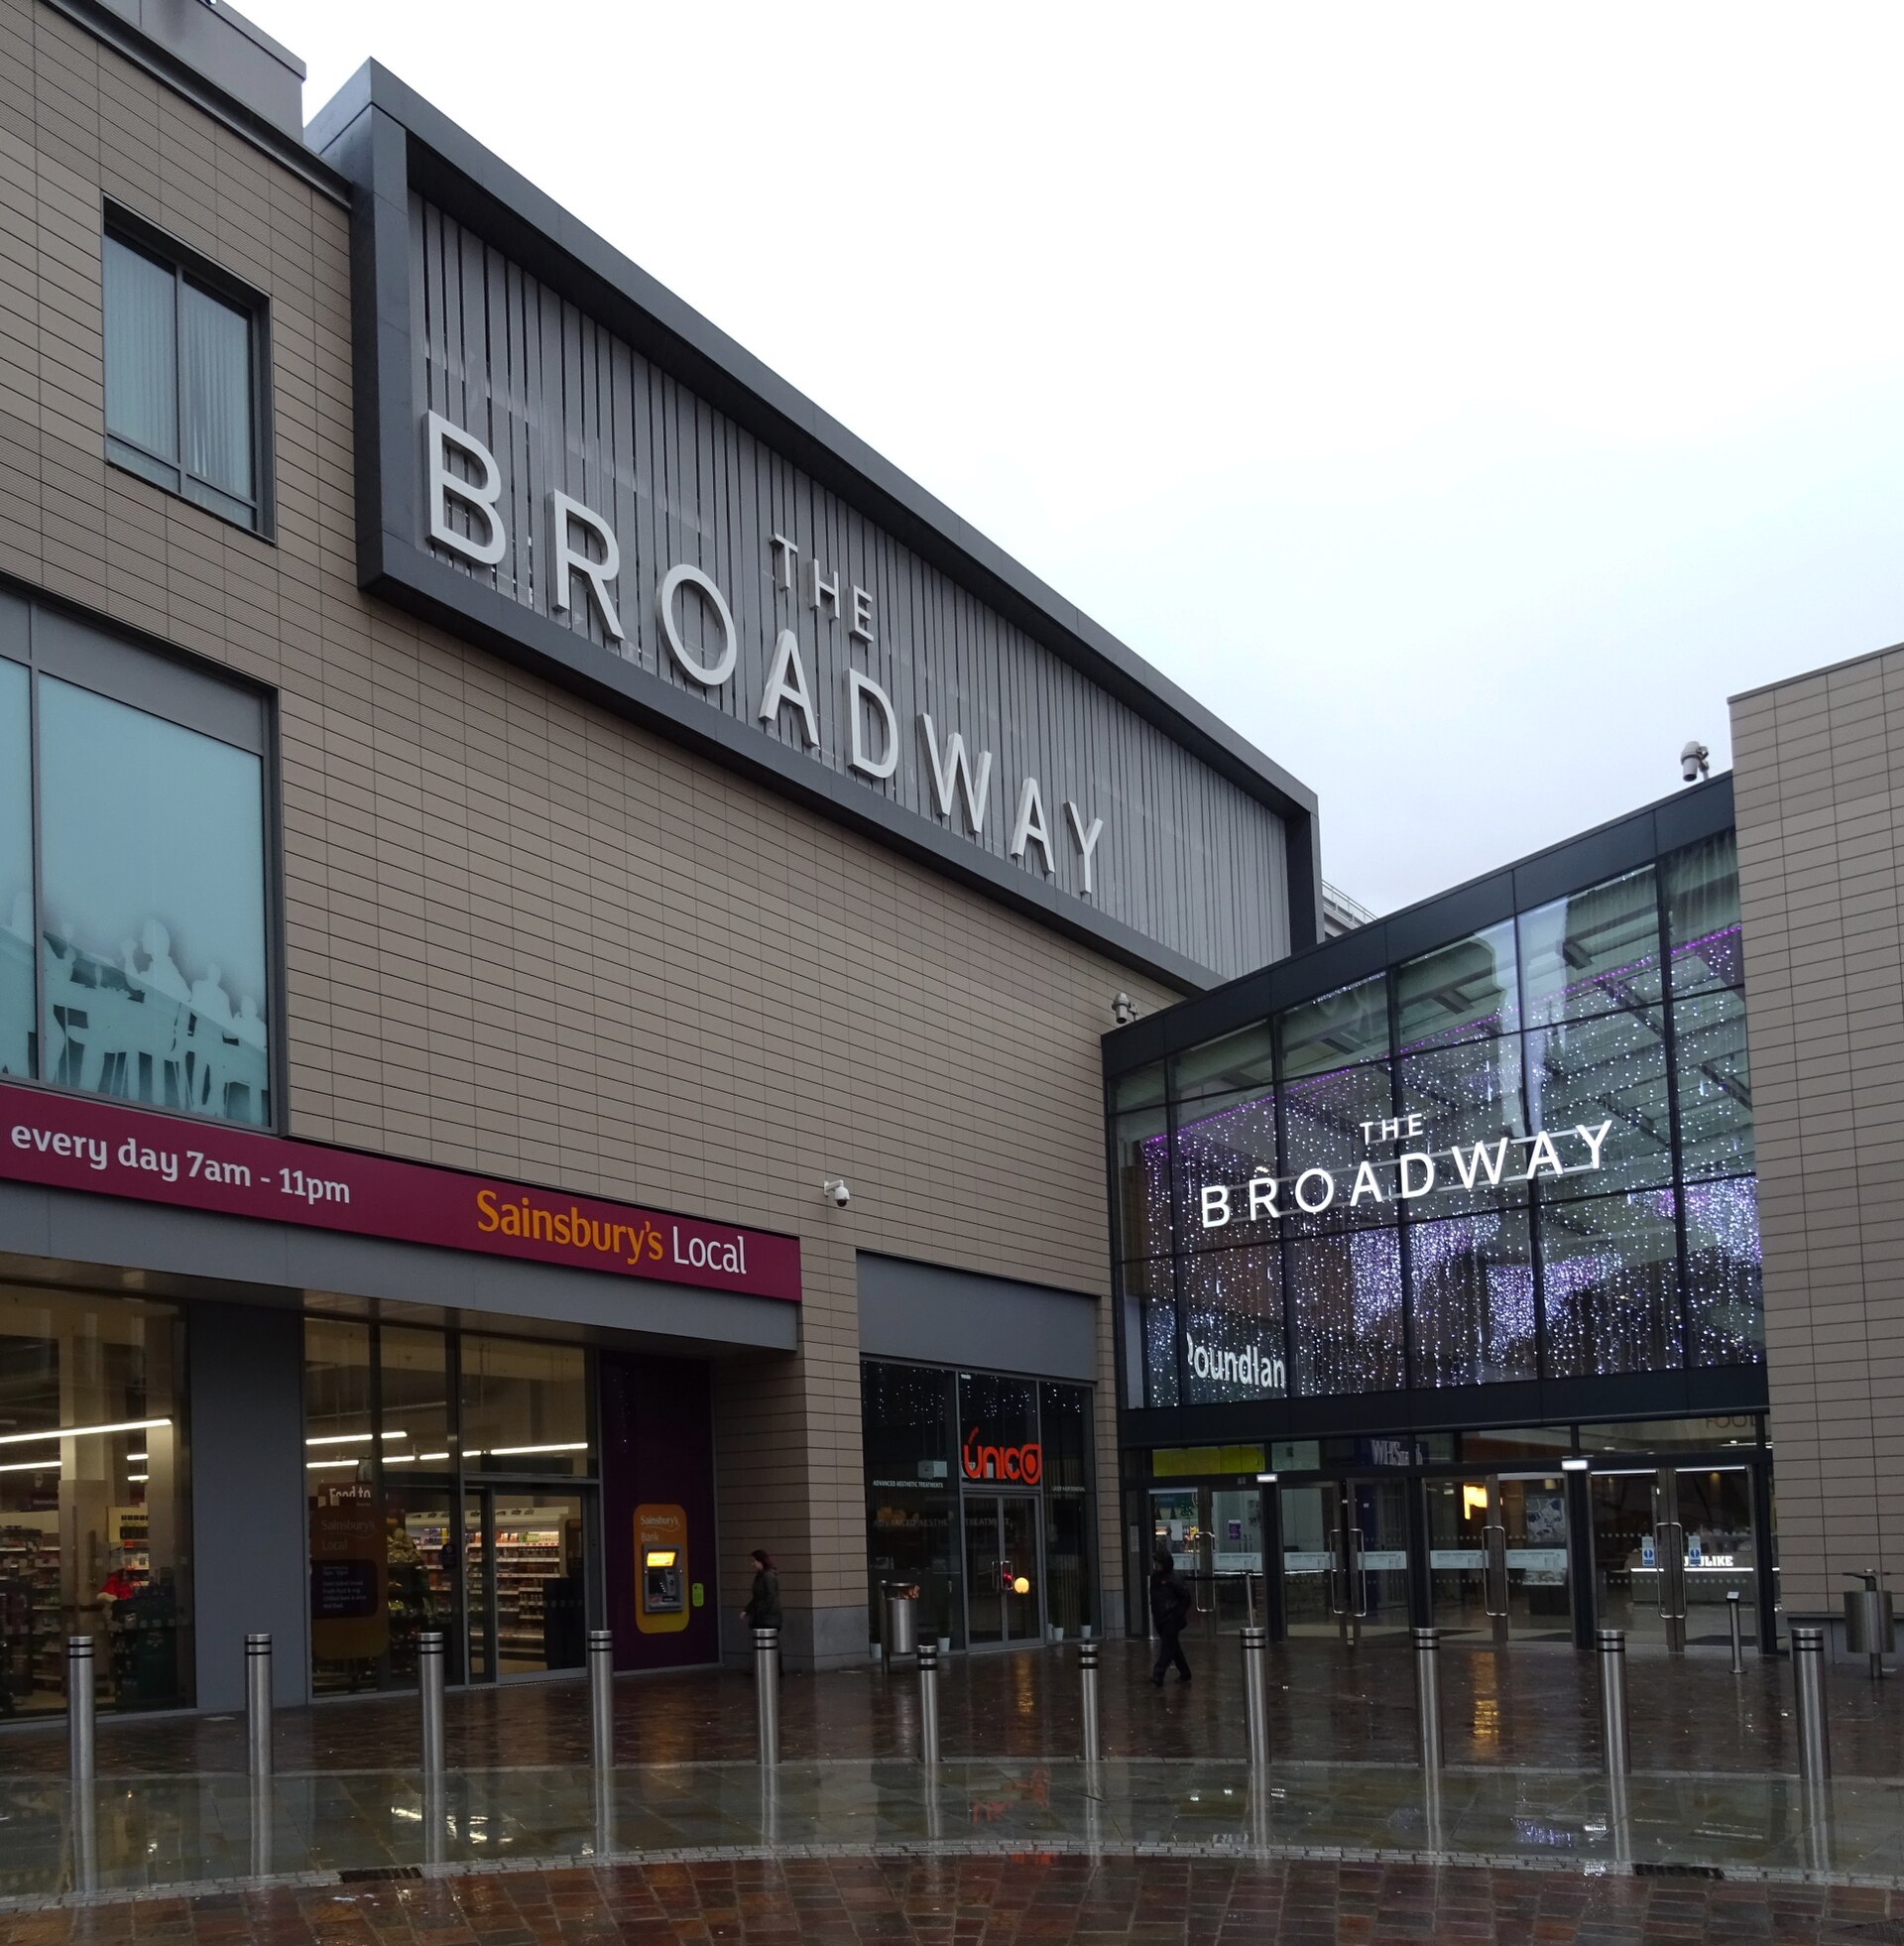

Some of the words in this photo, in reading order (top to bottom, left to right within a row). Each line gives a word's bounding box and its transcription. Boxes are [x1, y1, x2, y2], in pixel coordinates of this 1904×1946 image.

[769, 532, 875, 643] THE
[425, 409, 1104, 896] BROADWAY
[10, 1124, 109, 1171] every
[117, 1137, 179, 1182] day
[185, 1150, 252, 1188] 7am
[278, 1167, 351, 1205] 11pm
[1359, 1113, 1424, 1146] THE
[1201, 1120, 1613, 1229] BROADWAY
[476, 1189, 664, 1266] Sainsbury's
[671, 1225, 748, 1275] Local
[321, 1538, 348, 1551] Local
[640, 1515, 679, 1526] Sainsbury's
[641, 1531, 659, 1542] Bank
